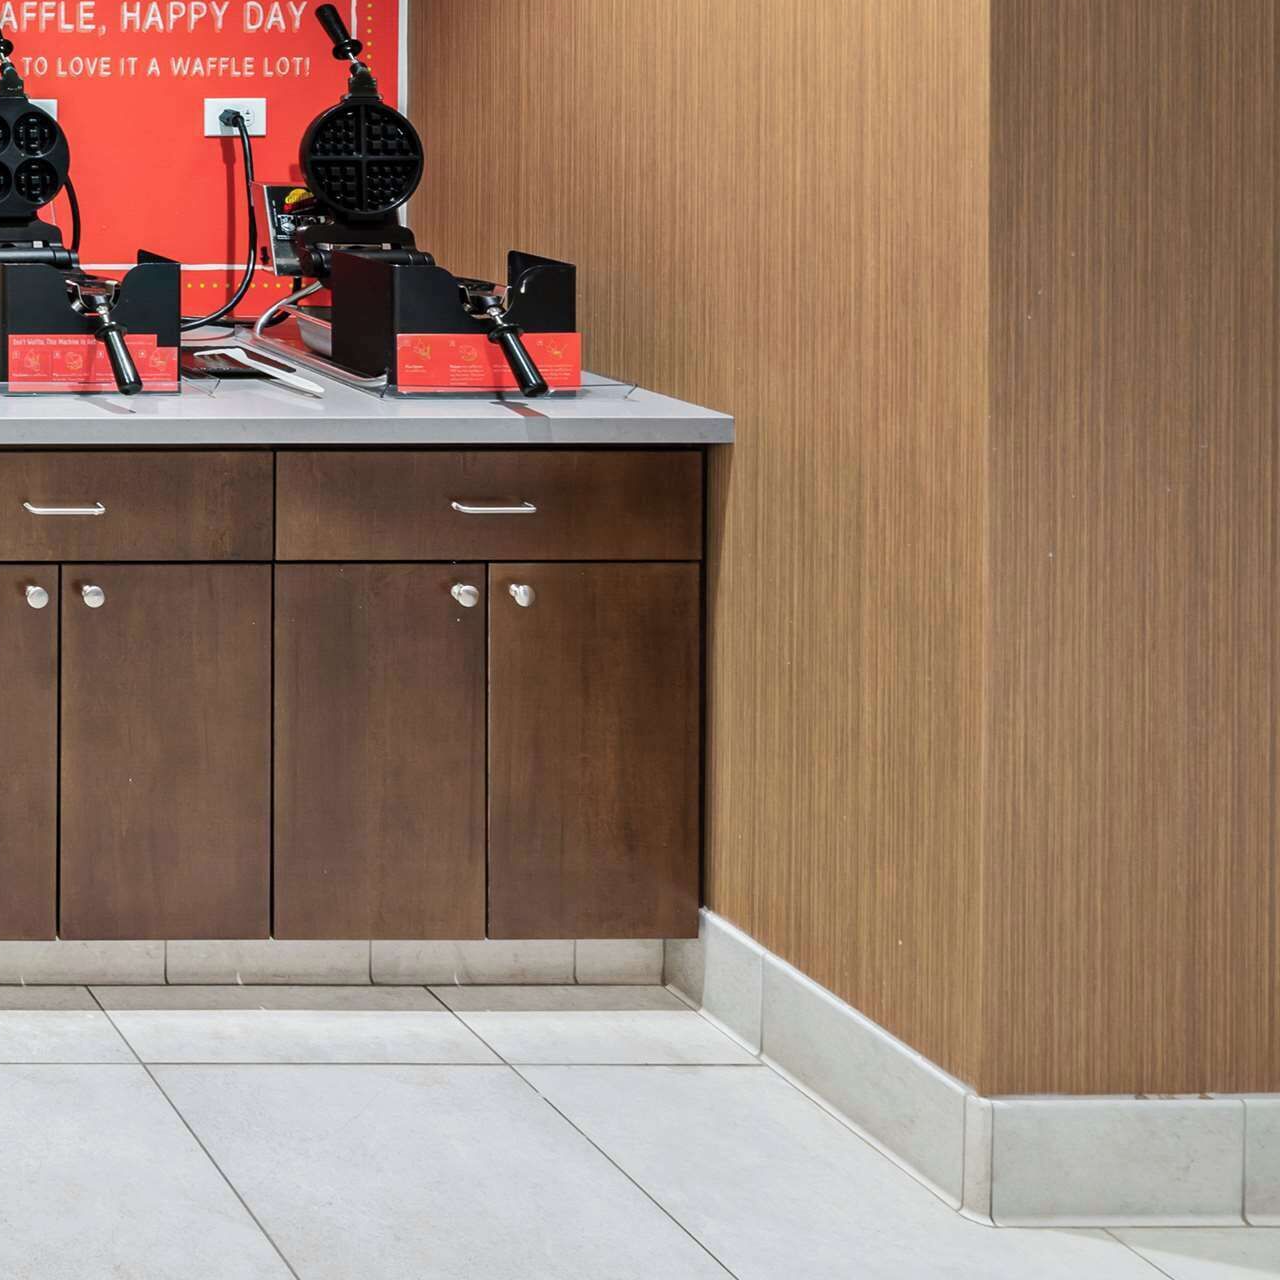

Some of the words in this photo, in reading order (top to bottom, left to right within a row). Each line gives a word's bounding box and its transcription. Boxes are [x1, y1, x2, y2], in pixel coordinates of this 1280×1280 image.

[121, 1, 230, 33] HAPPY
[243, 1, 308, 33] DAY
[21, 57, 49, 78] TO
[56, 56, 112, 78] LOVE
[120, 56, 139, 77] IT
[147, 56, 161, 77] A
[170, 56, 255, 78] WAFFLE
[263, 56, 310, 77] LOT!
